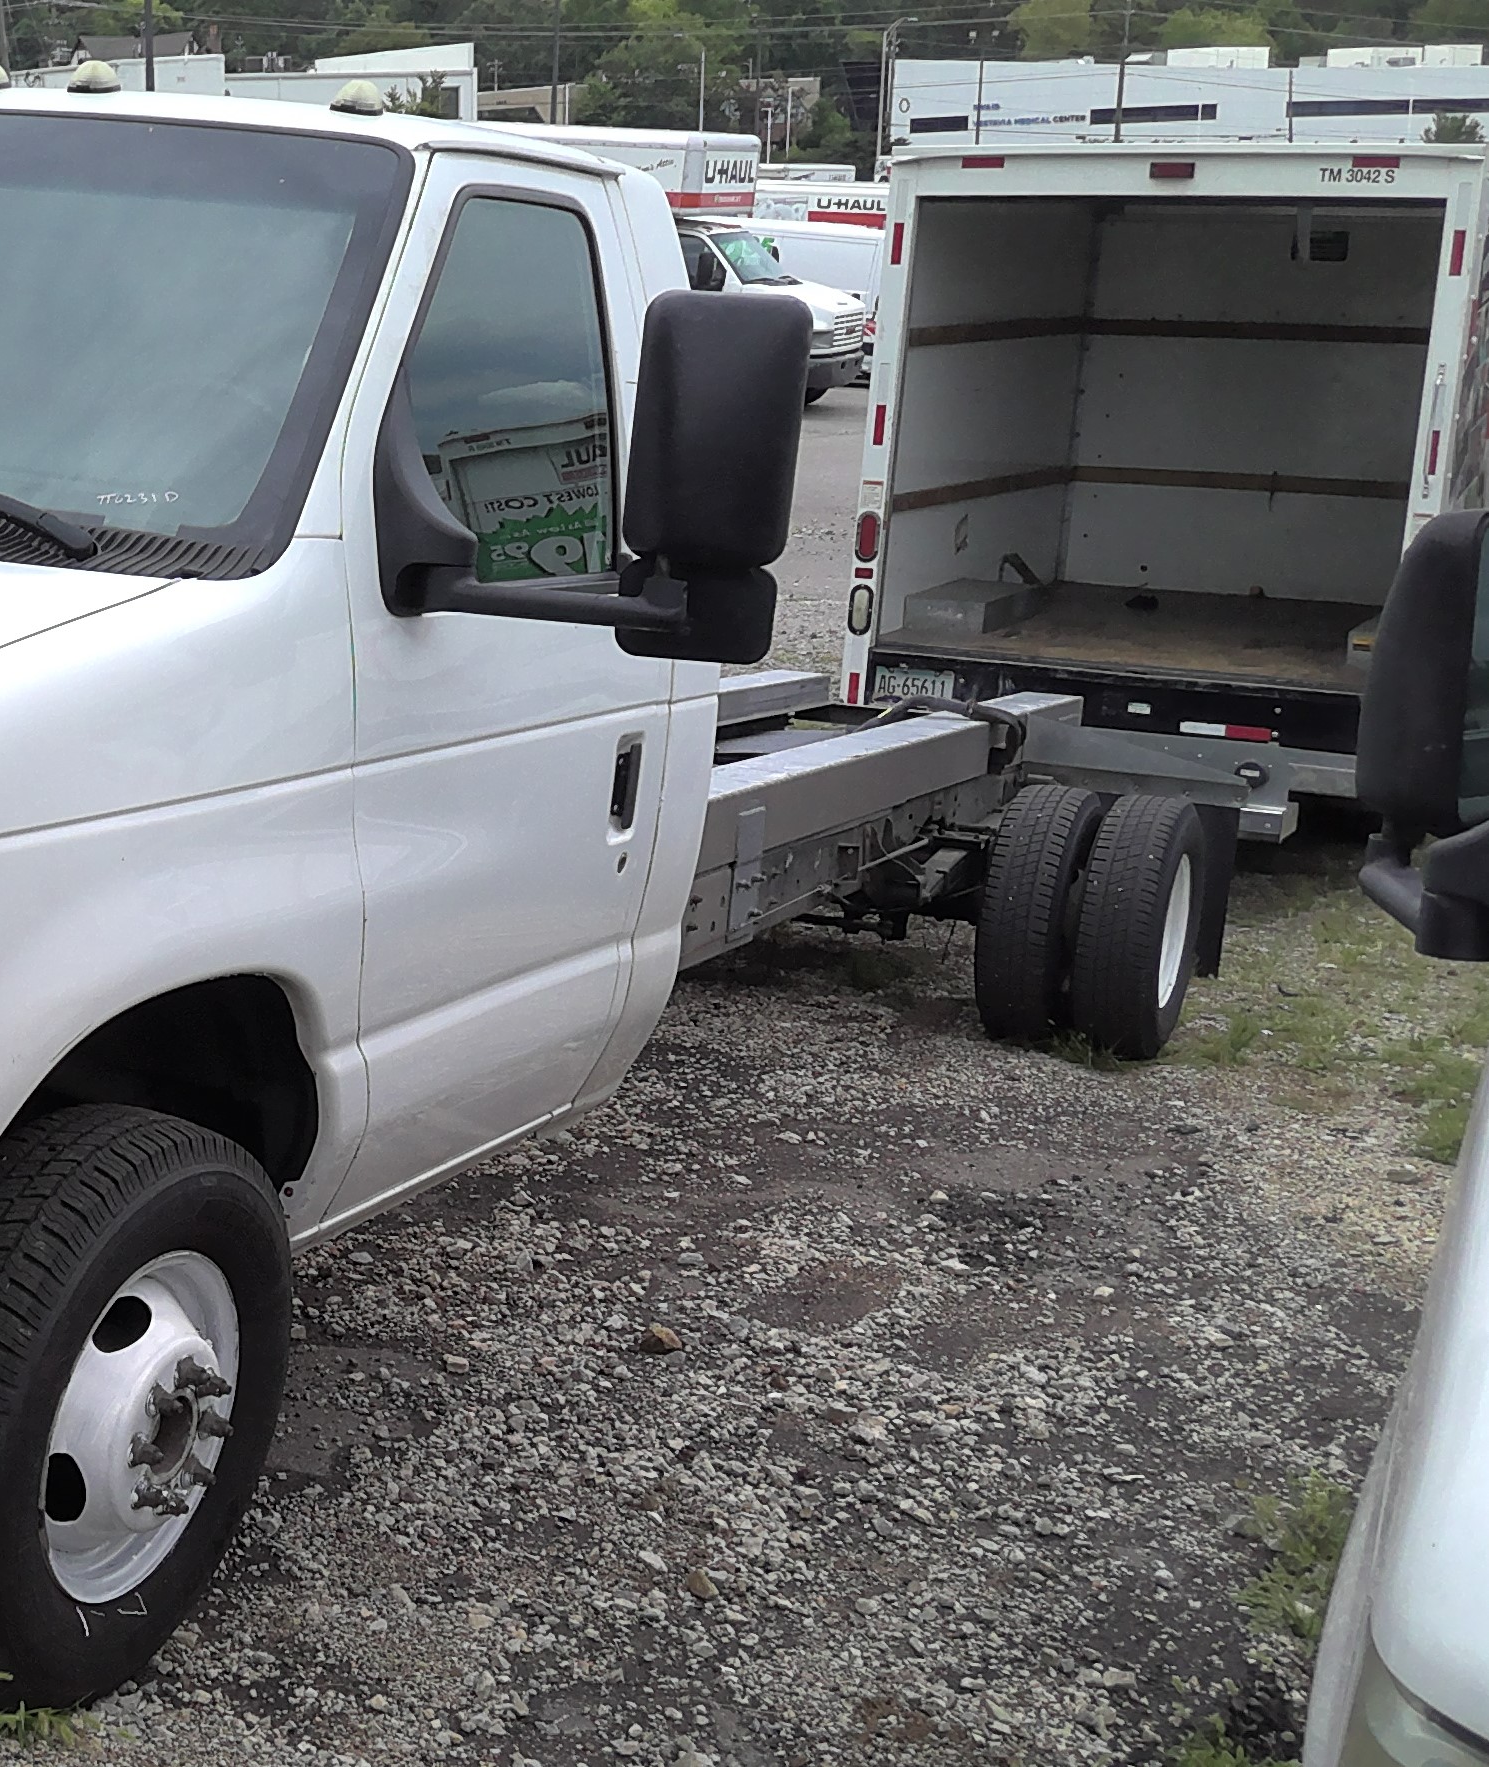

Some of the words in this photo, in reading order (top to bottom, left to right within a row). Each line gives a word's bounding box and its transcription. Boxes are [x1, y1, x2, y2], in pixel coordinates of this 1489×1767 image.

[704, 160, 754, 184] U-HAUL
[1319, 168, 1343, 183] TM
[1345, 168, 1381, 184] 3042
[1385, 169, 1395, 184] S
[816, 198, 886, 212] U-HAUL
